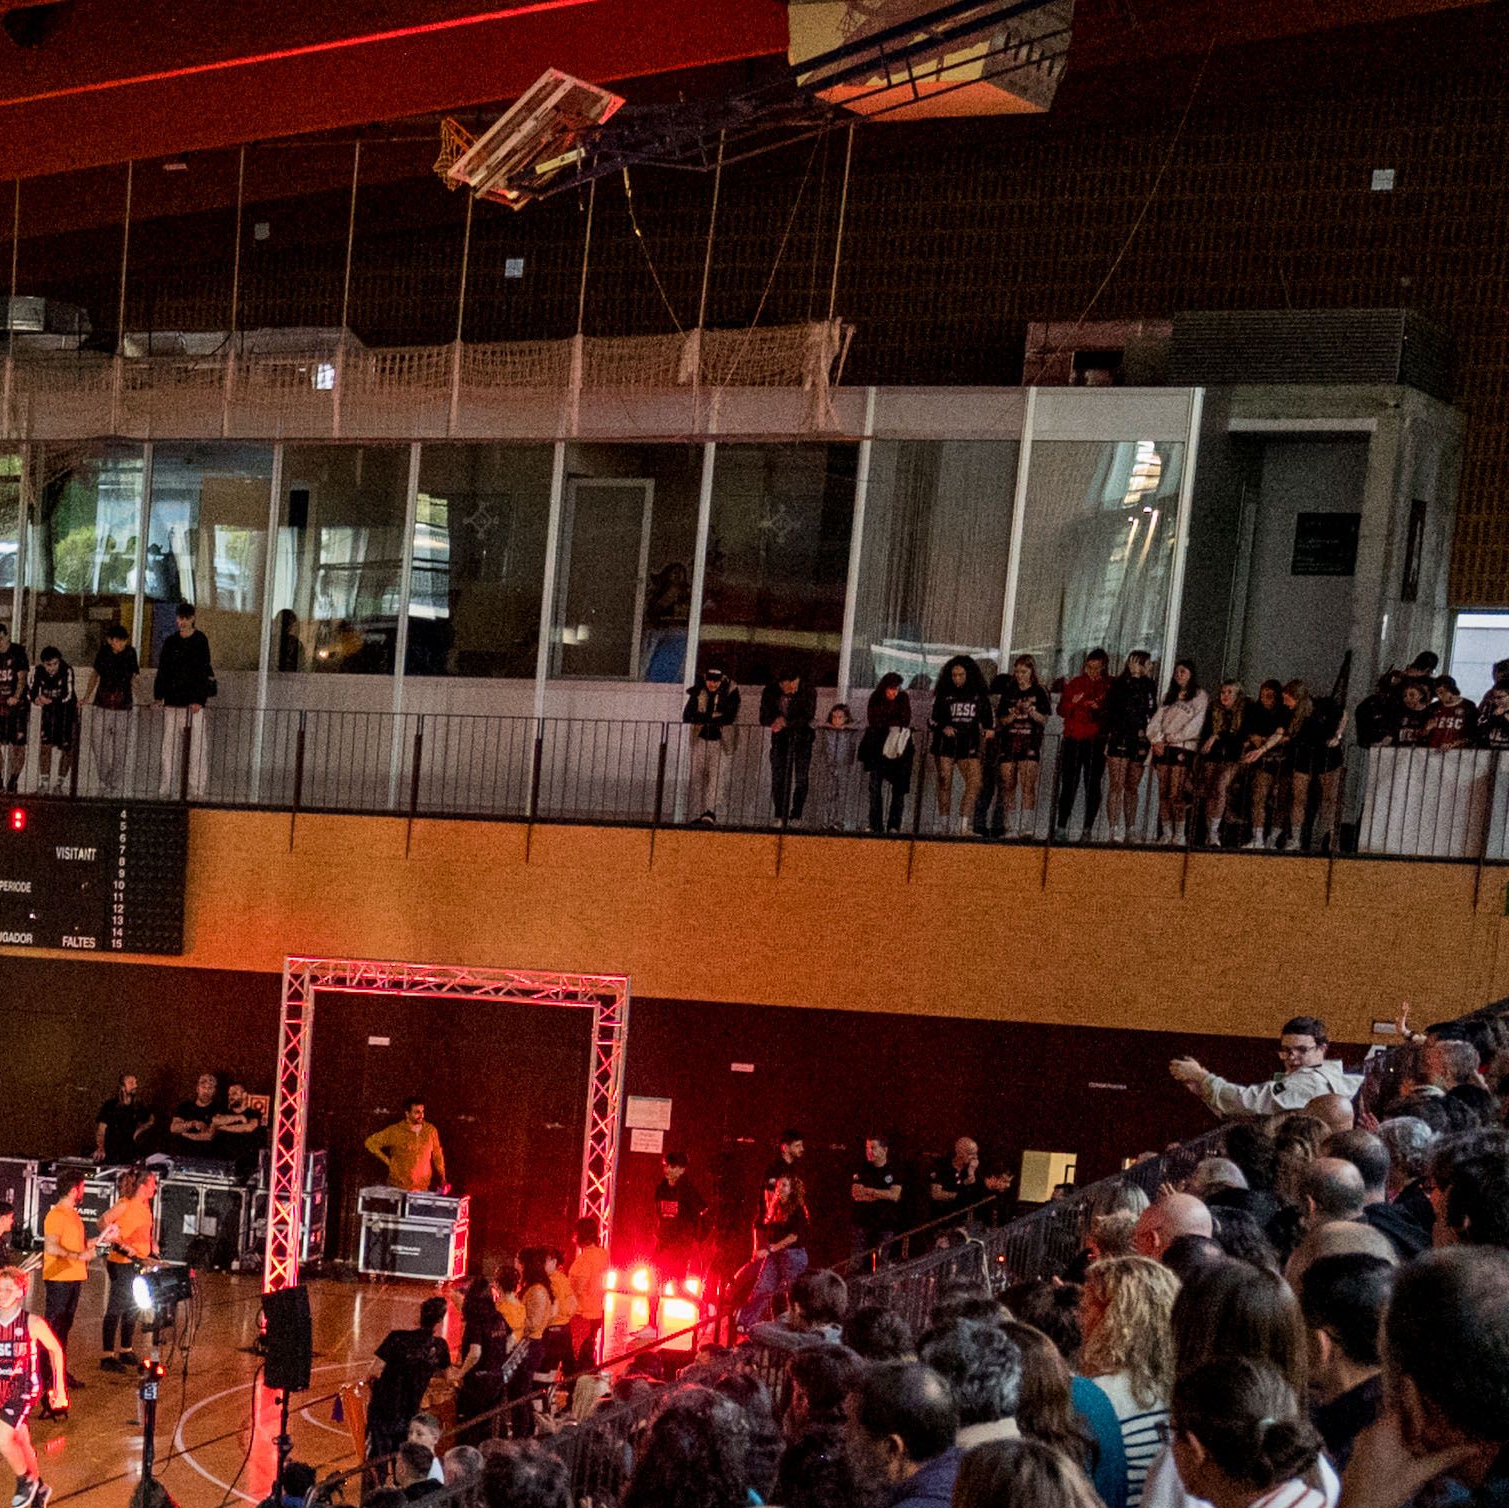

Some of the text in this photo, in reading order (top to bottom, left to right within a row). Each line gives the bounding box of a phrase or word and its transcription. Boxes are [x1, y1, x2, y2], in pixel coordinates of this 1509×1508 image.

[1437, 716, 1464, 730] ESC
[120, 810, 127, 819] 4
[120, 821, 127, 831] 5
[119, 833, 126, 843] 6
[55, 846, 97, 862] VISITANT
[119, 845, 126, 854] 7
[118, 869, 126, 878] 9
[113, 880, 126, 890] 10
[113, 892, 124, 902] 11
[113, 904, 125, 914] 12
[112, 916, 124, 925] 13
[112, 927, 123, 937] 14
[62, 935, 97, 949] FALTES
